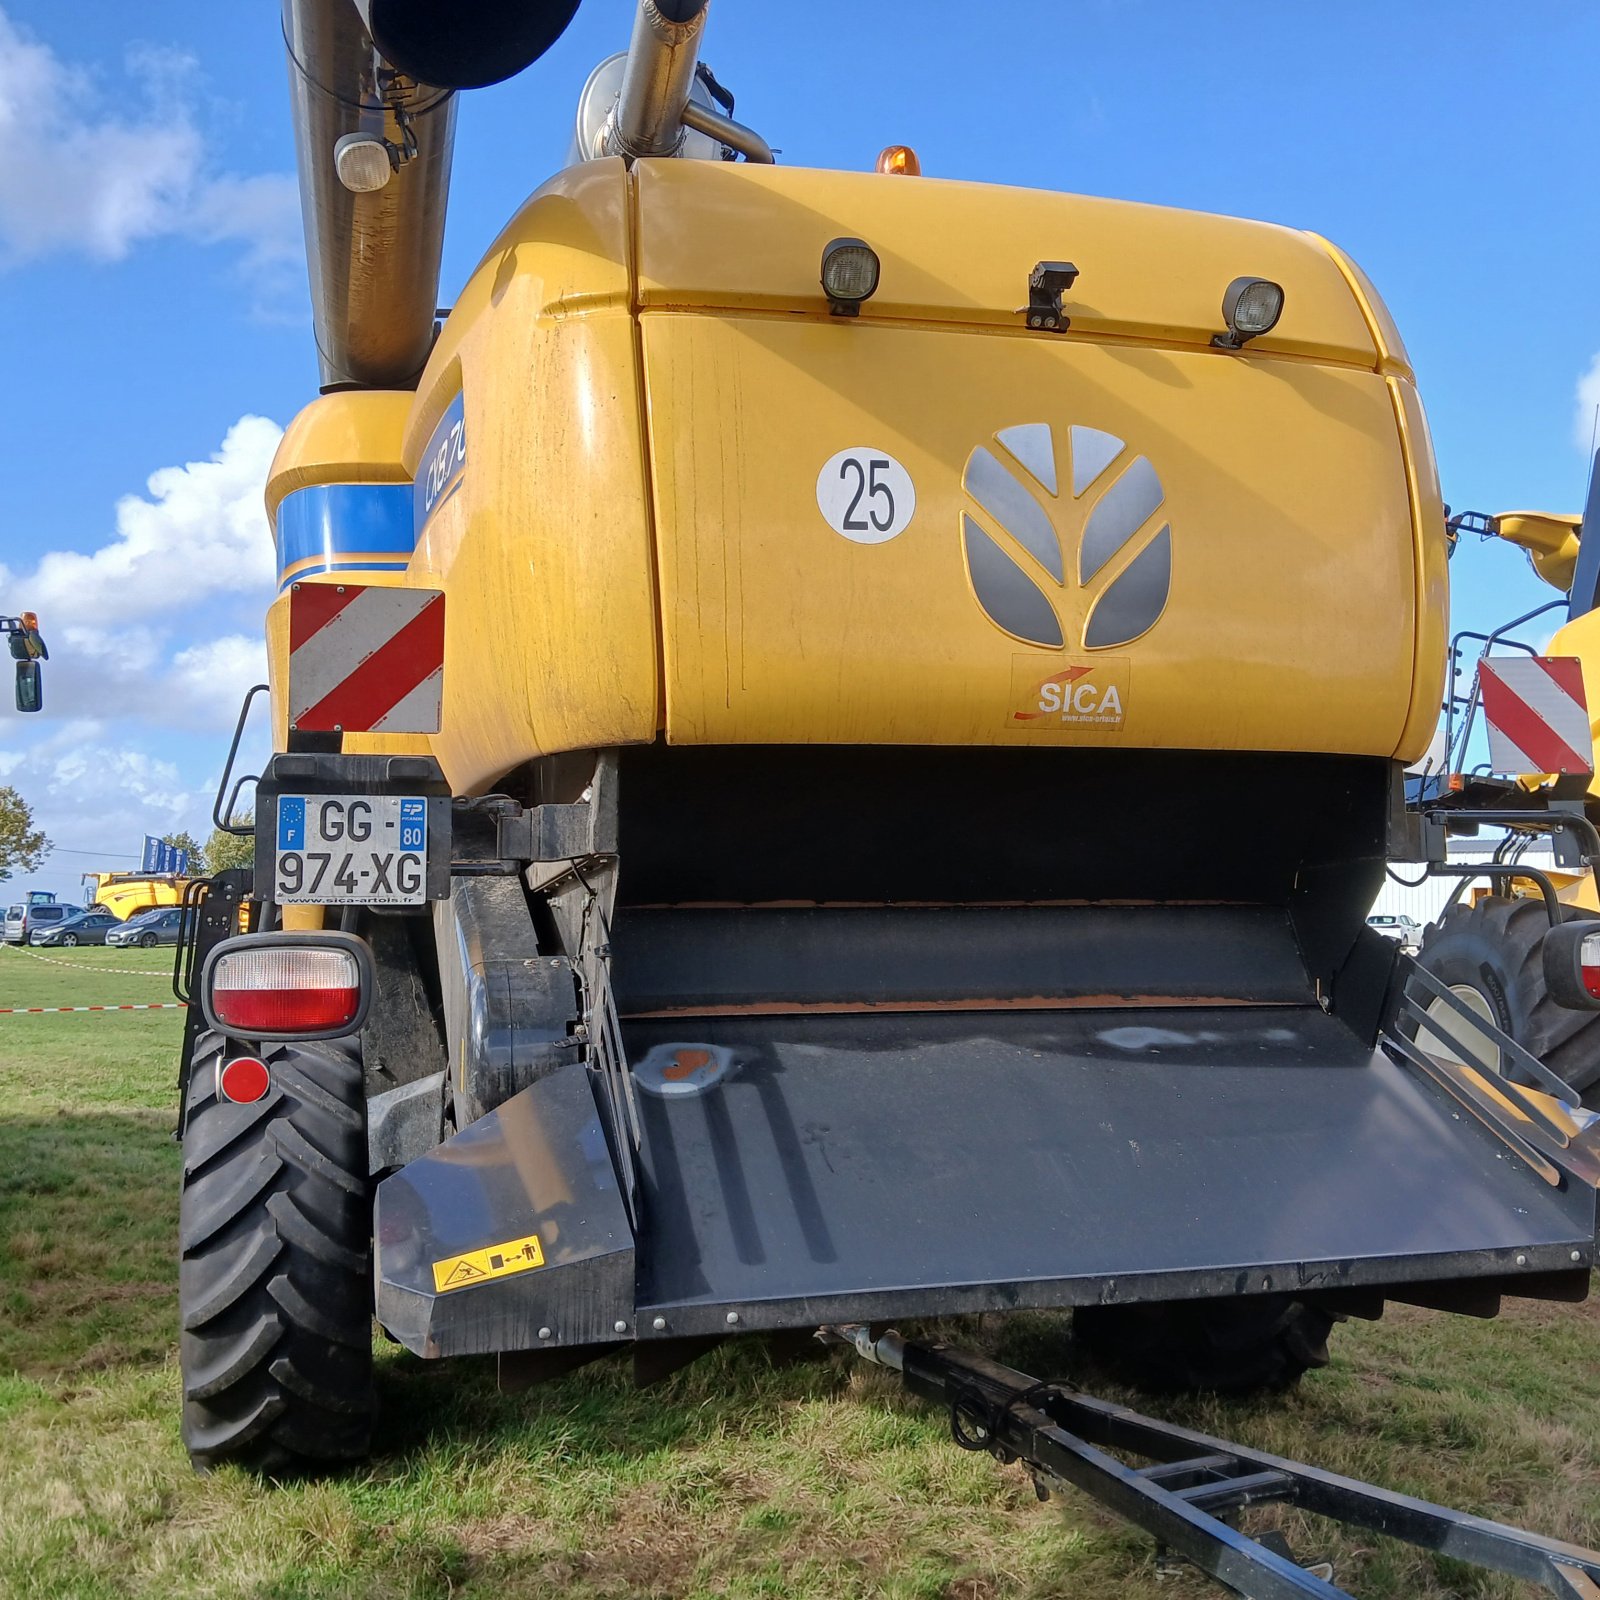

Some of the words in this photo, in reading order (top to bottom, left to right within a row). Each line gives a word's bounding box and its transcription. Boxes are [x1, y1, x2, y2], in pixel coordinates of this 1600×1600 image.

[840, 458, 895, 532] 25
[1038, 683, 1122, 713] SICA
[287, 829, 296, 842] F
[319, 800, 372, 842] GG
[403, 828, 422, 846] 80
[278, 852, 421, 894] 974-XG
